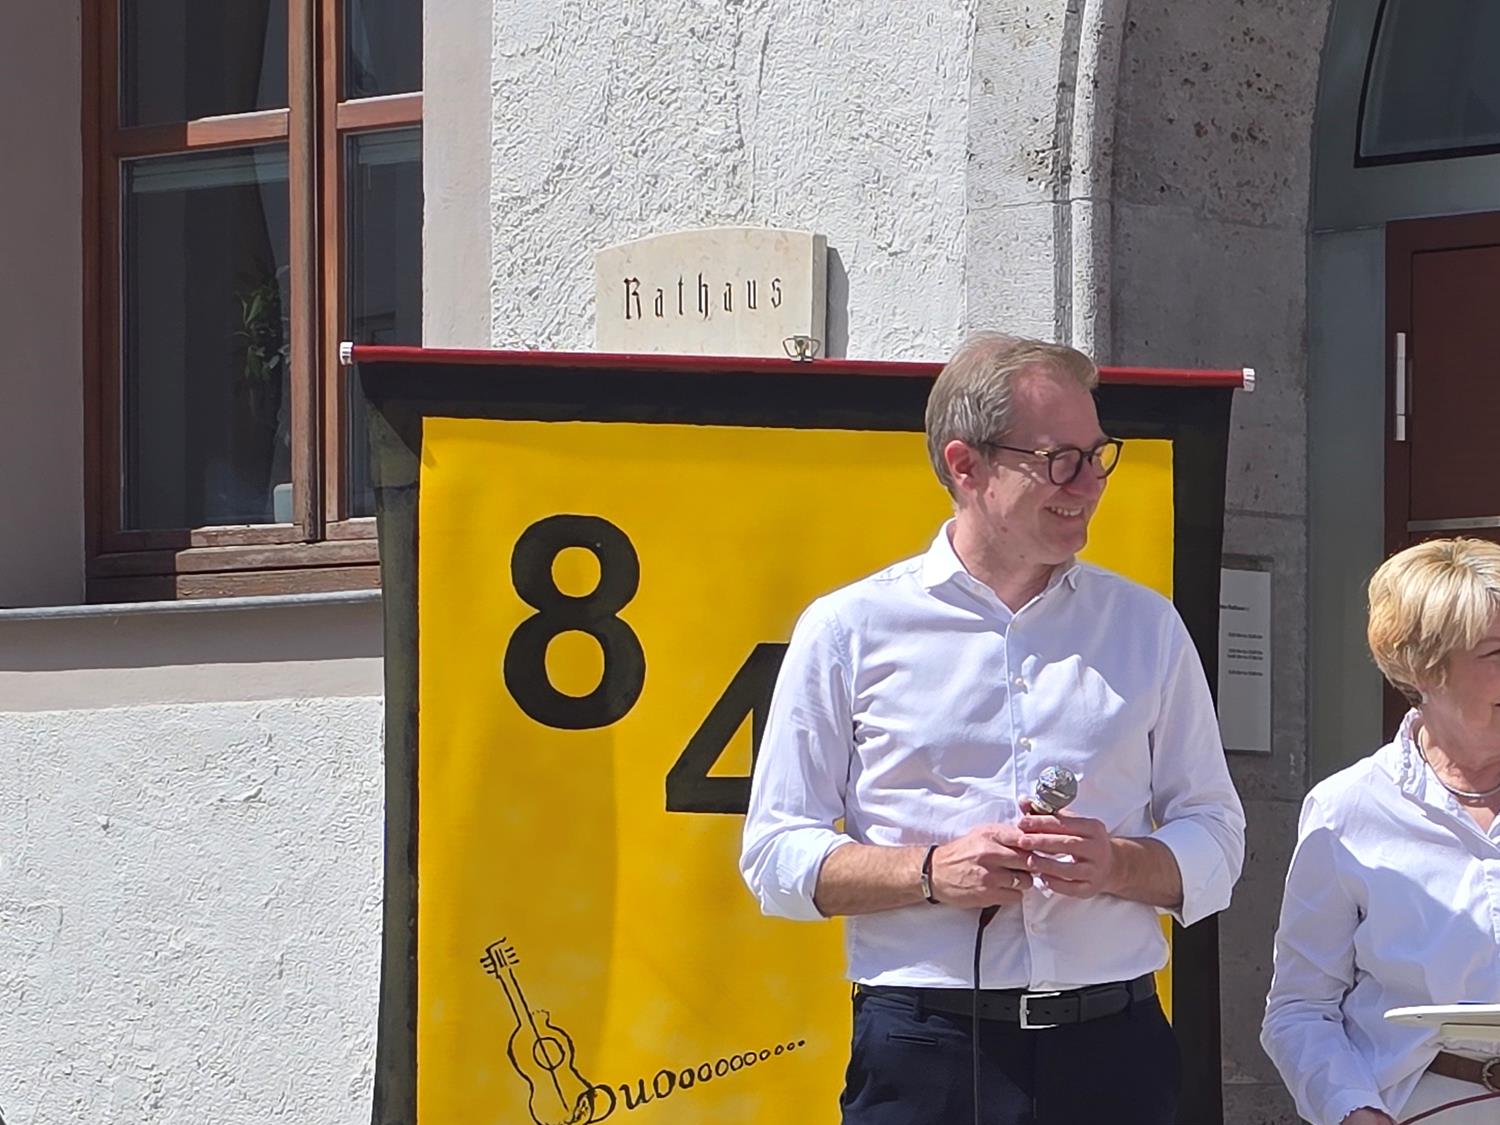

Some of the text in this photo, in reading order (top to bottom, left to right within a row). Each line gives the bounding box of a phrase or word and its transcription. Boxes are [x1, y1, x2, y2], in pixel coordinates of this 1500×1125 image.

[623, 272, 783, 321] Rathaus
[503, 513, 646, 730] 8
[665, 643, 791, 815] 4
